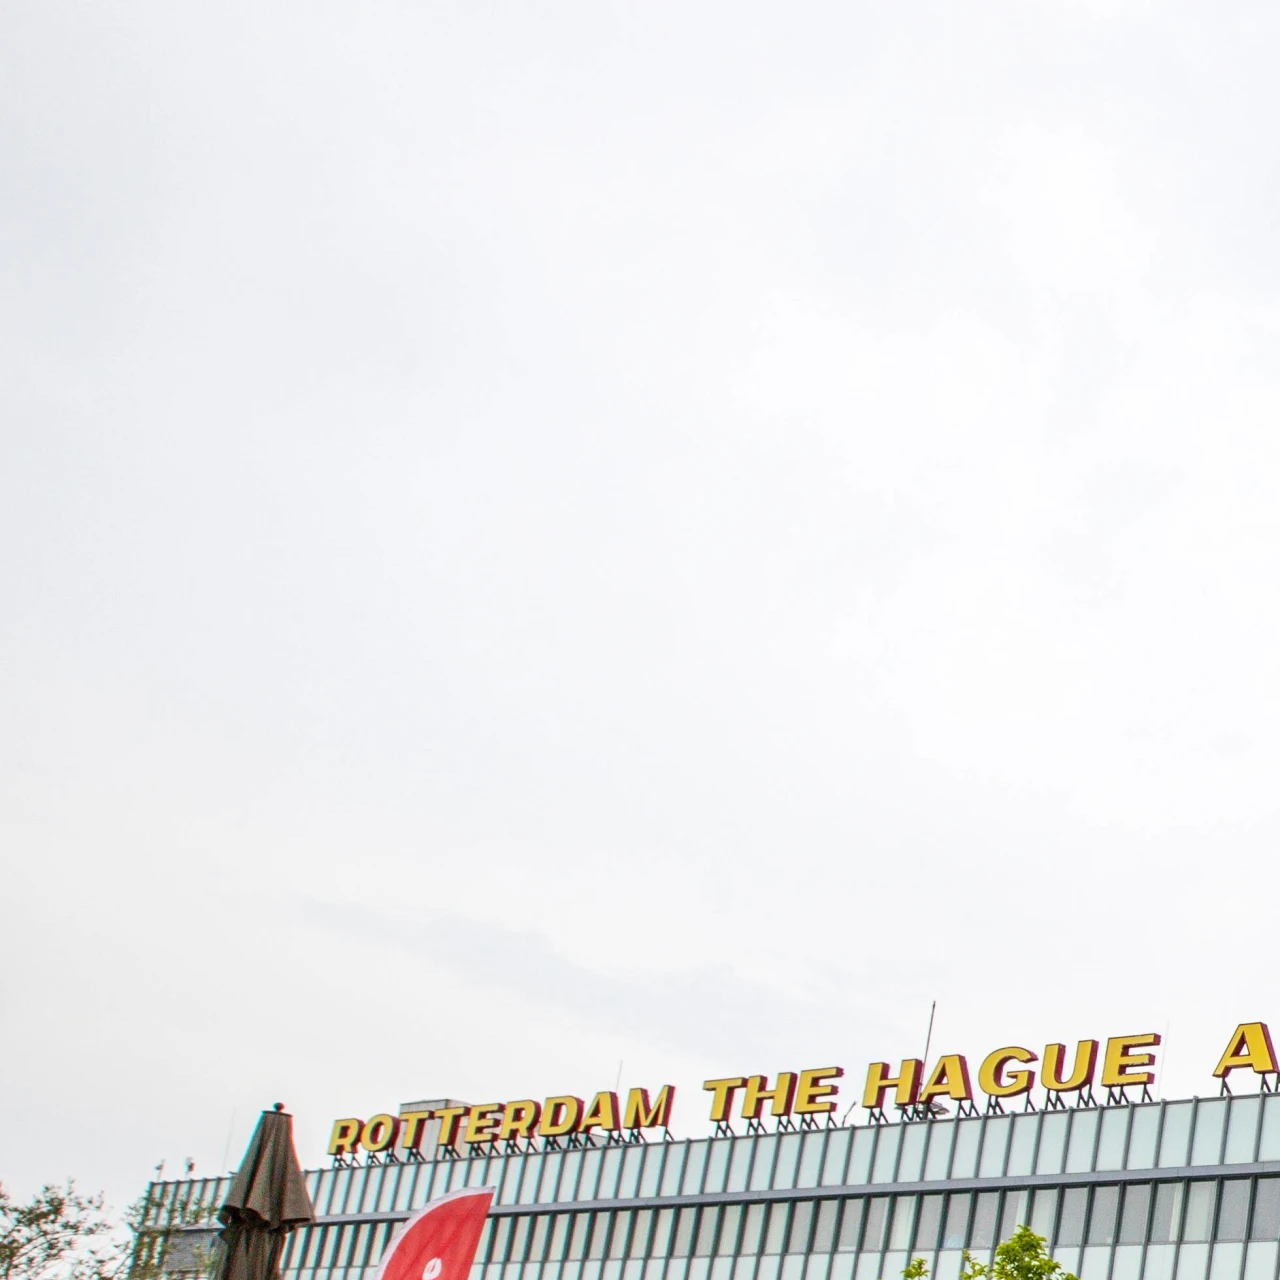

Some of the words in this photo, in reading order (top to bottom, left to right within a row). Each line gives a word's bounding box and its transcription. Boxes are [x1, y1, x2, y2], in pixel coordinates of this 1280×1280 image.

[328, 1085, 675, 1156] ROTTERDAM
[703, 1066, 844, 1122] THE
[863, 1033, 1161, 1110] HAGUE
